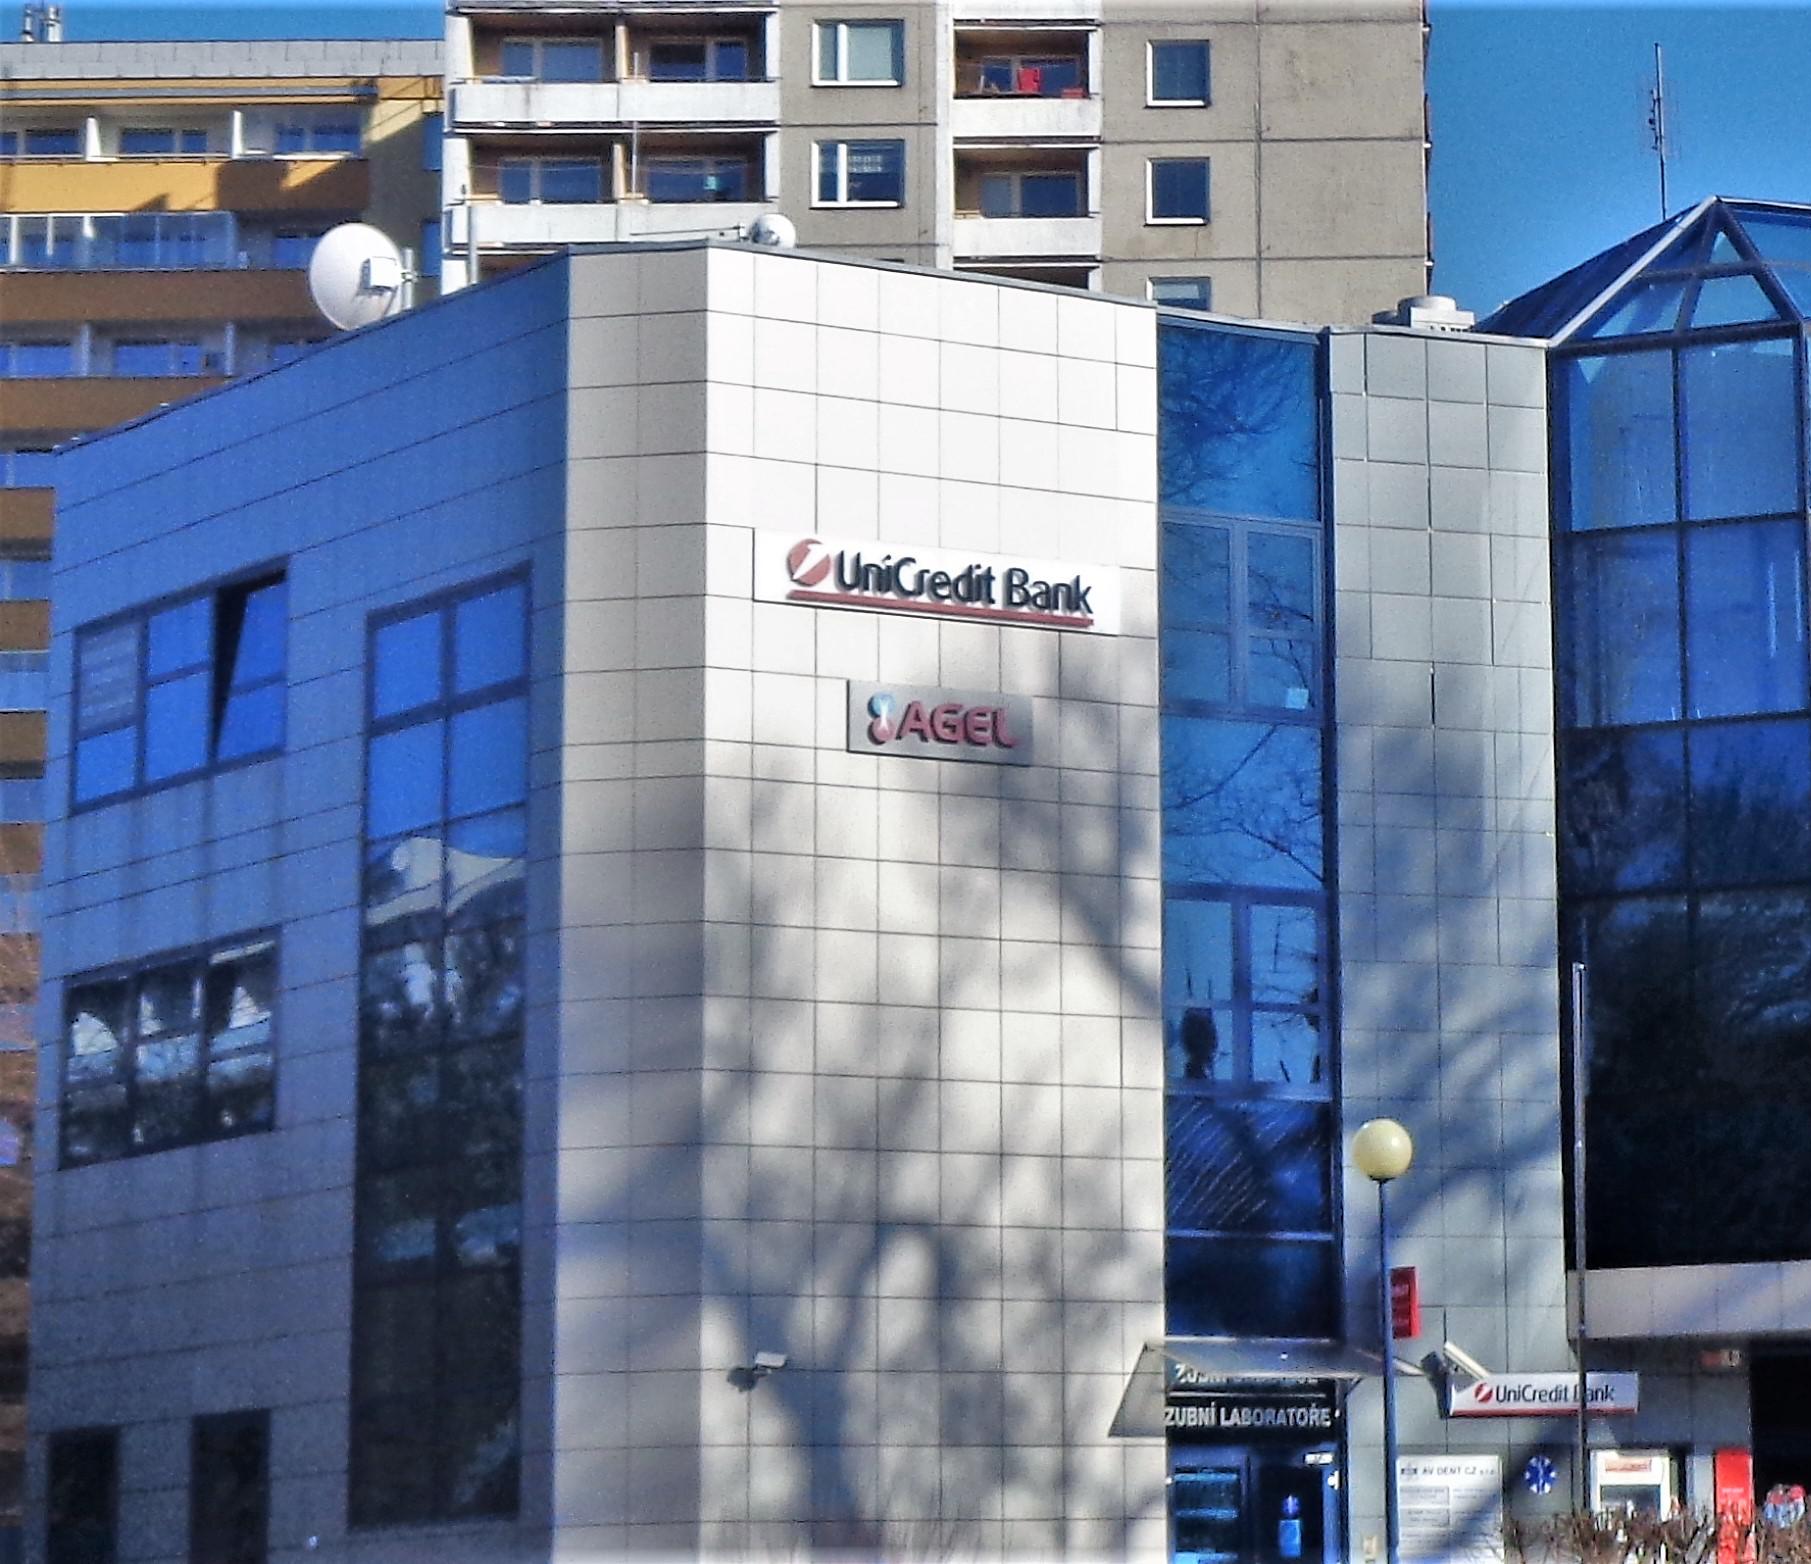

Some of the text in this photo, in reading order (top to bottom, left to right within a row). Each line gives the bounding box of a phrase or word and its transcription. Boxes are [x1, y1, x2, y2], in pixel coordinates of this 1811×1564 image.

[834, 550, 1094, 615] UniCredit Bank
[895, 700, 1020, 749] AGEL
[1496, 1383, 1569, 1403] UniCredit
[1165, 1402, 1332, 1428] ZUBNÍ LABORATOŘE
[1437, 1465, 1462, 1476] DENT
